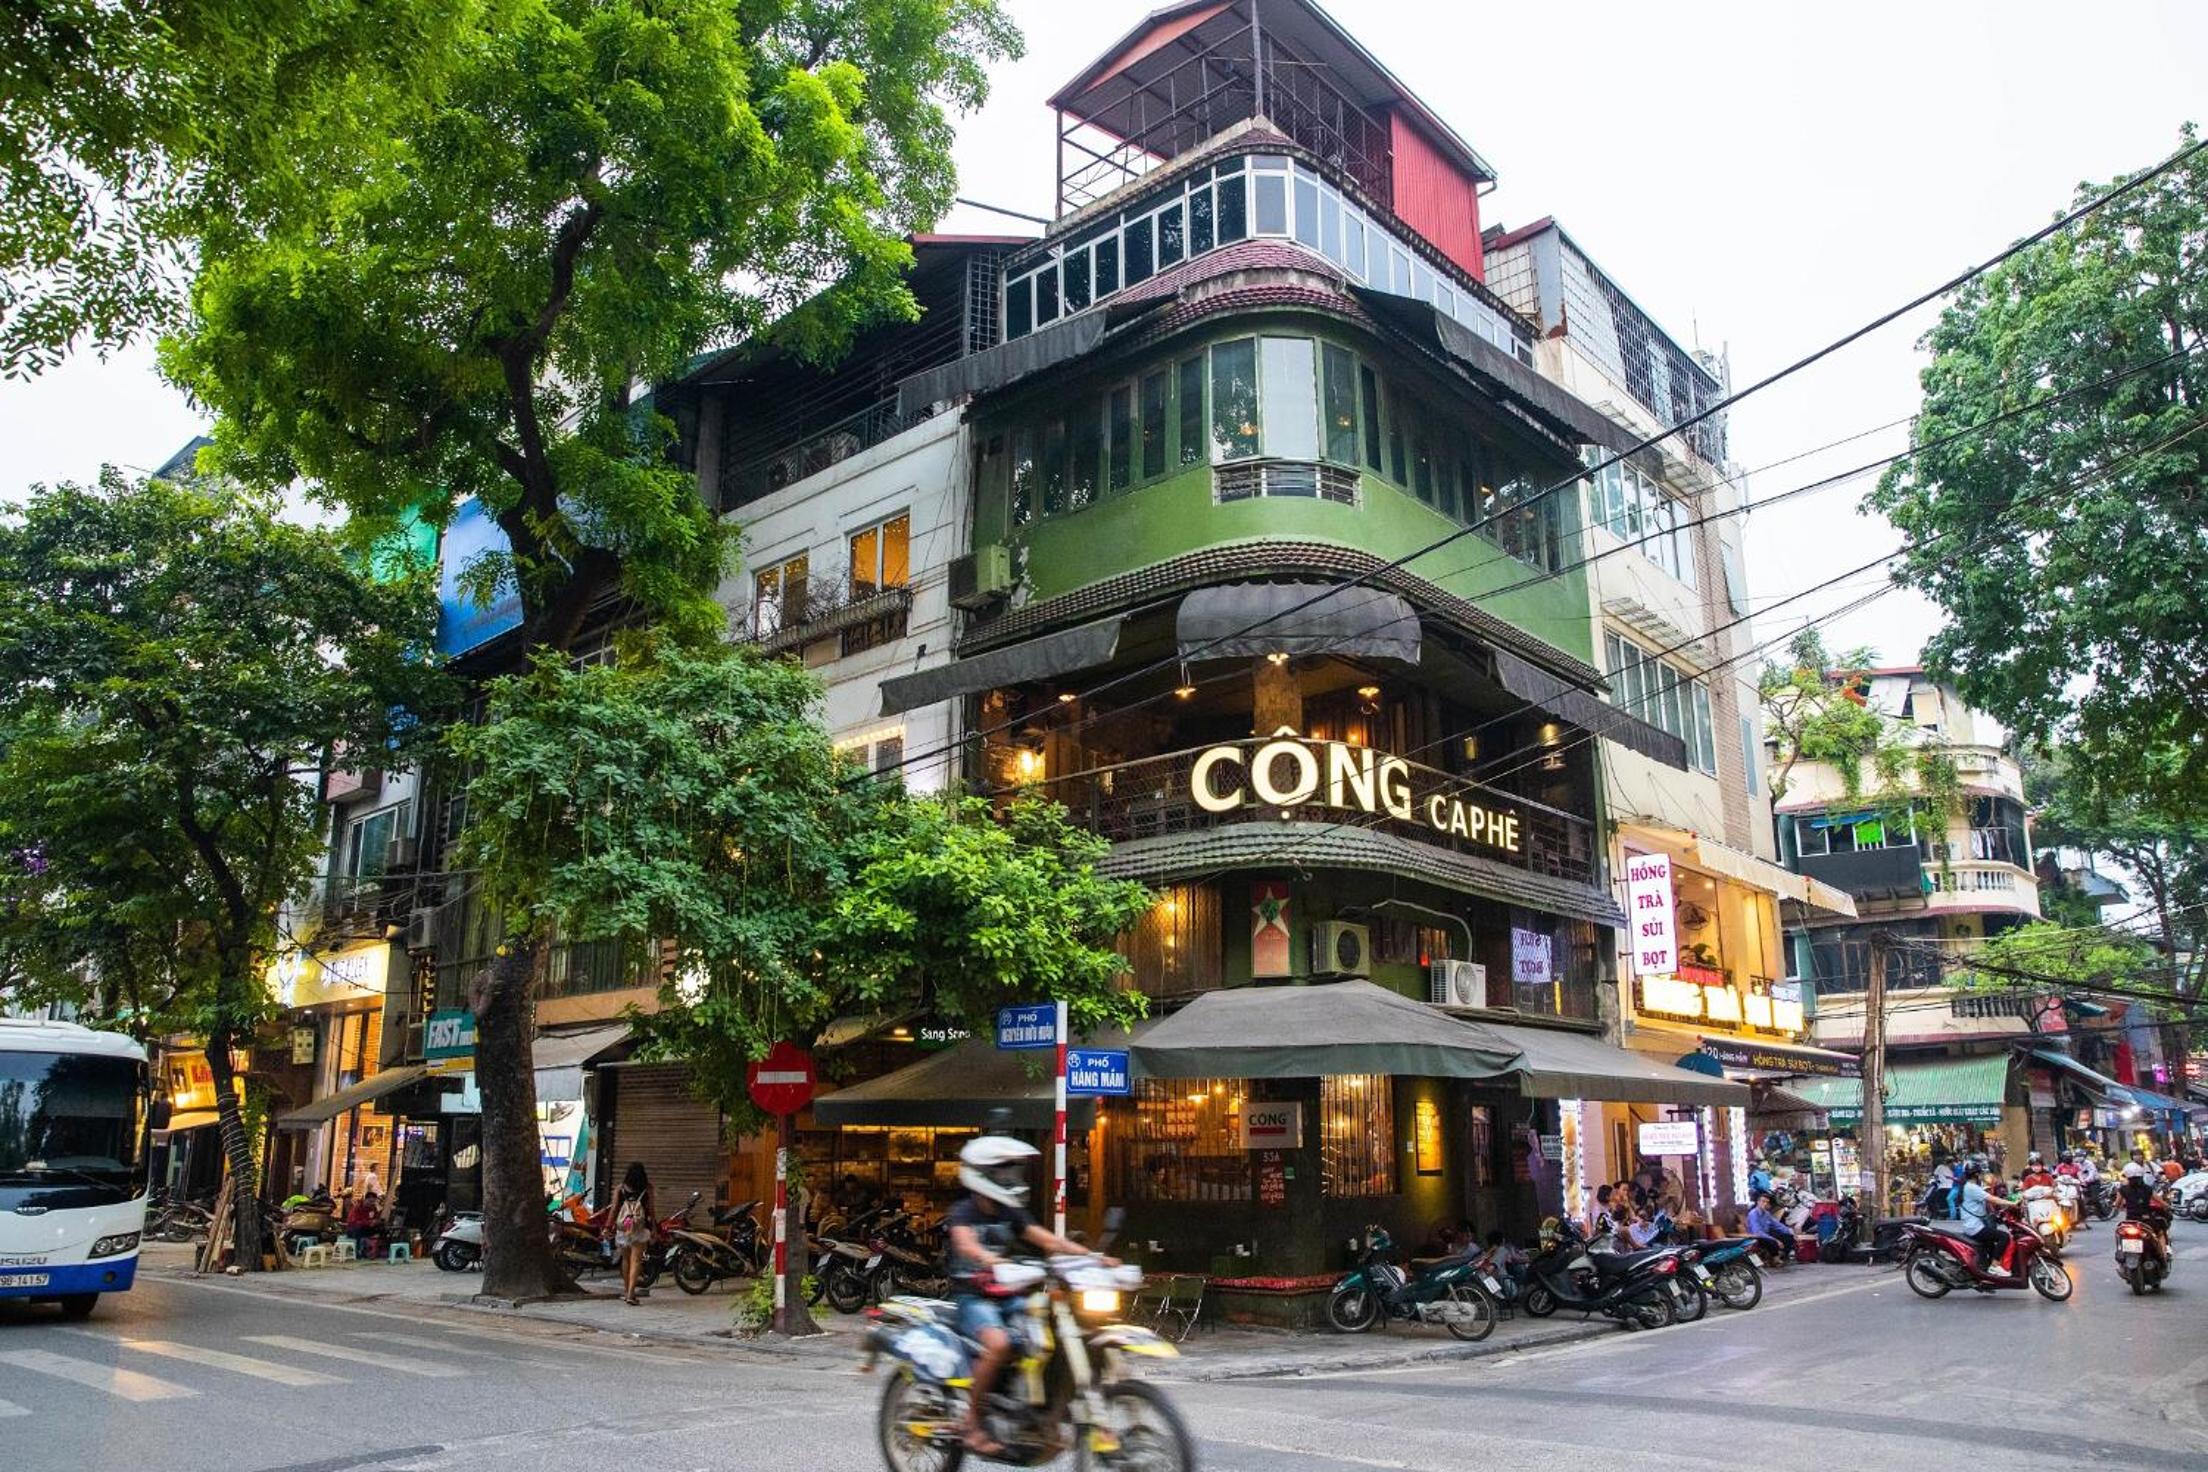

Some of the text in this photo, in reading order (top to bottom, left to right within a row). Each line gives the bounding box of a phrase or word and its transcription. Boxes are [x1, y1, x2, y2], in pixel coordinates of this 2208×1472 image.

[1191, 725, 1412, 820] CỘNG
[1637, 889, 1664, 909] TRÀ
[1642, 950, 1667, 969] BỌT
[1017, 1011, 1038, 1022] PHỐ
[427, 1018, 462, 1049] FAST
[920, 1027, 946, 1042] Sang
[1087, 1055, 1110, 1068] PHỐ
[1071, 1068, 1099, 1087] HÀNG
